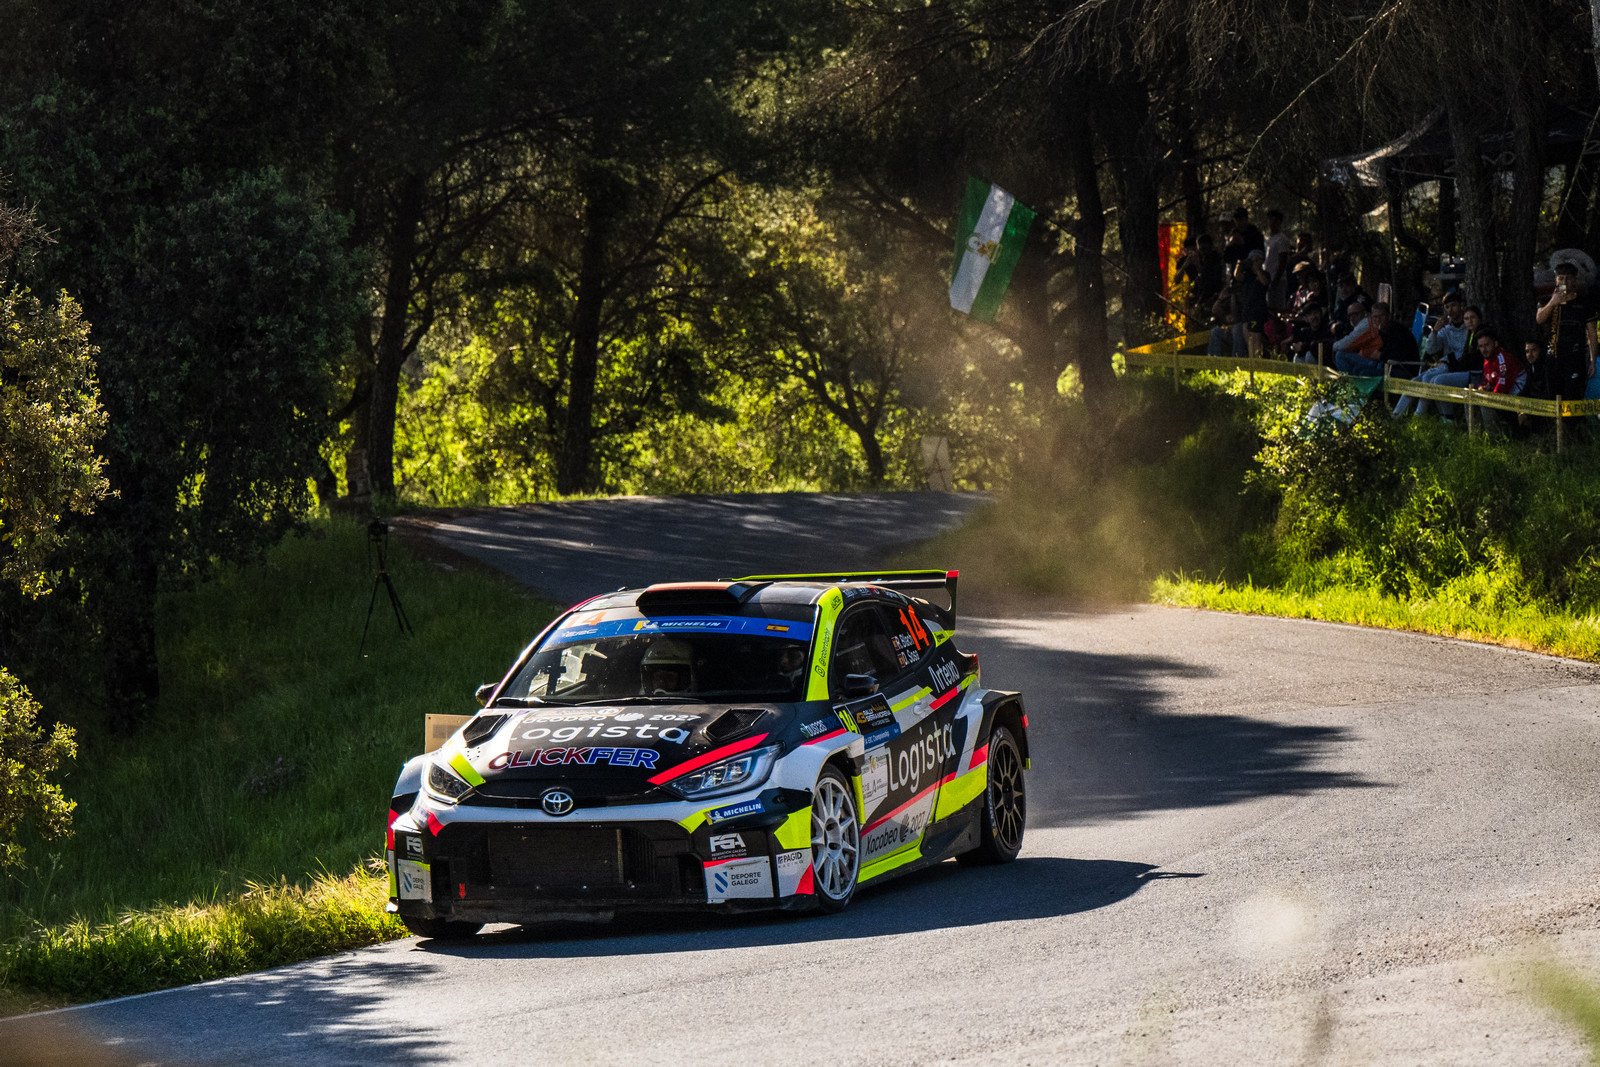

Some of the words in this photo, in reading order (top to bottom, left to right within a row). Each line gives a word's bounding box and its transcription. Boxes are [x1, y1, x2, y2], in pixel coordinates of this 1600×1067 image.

[565, 611, 608, 628] 14
[898, 604, 929, 650] 14
[649, 713, 702, 721] 2027
[838, 709, 859, 734] 14
[510, 722, 691, 745] ogista
[488, 746, 661, 770] CLICKFER
[886, 721, 957, 794] Logista
[723, 803, 762, 817] MICHELIN
[865, 827, 898, 856] Xacobeo
[910, 811, 925, 834] 2027
[783, 852, 802, 863] PAGID
[731, 871, 762, 880] DEPORTE
[731, 878, 759, 887] GALEGO
